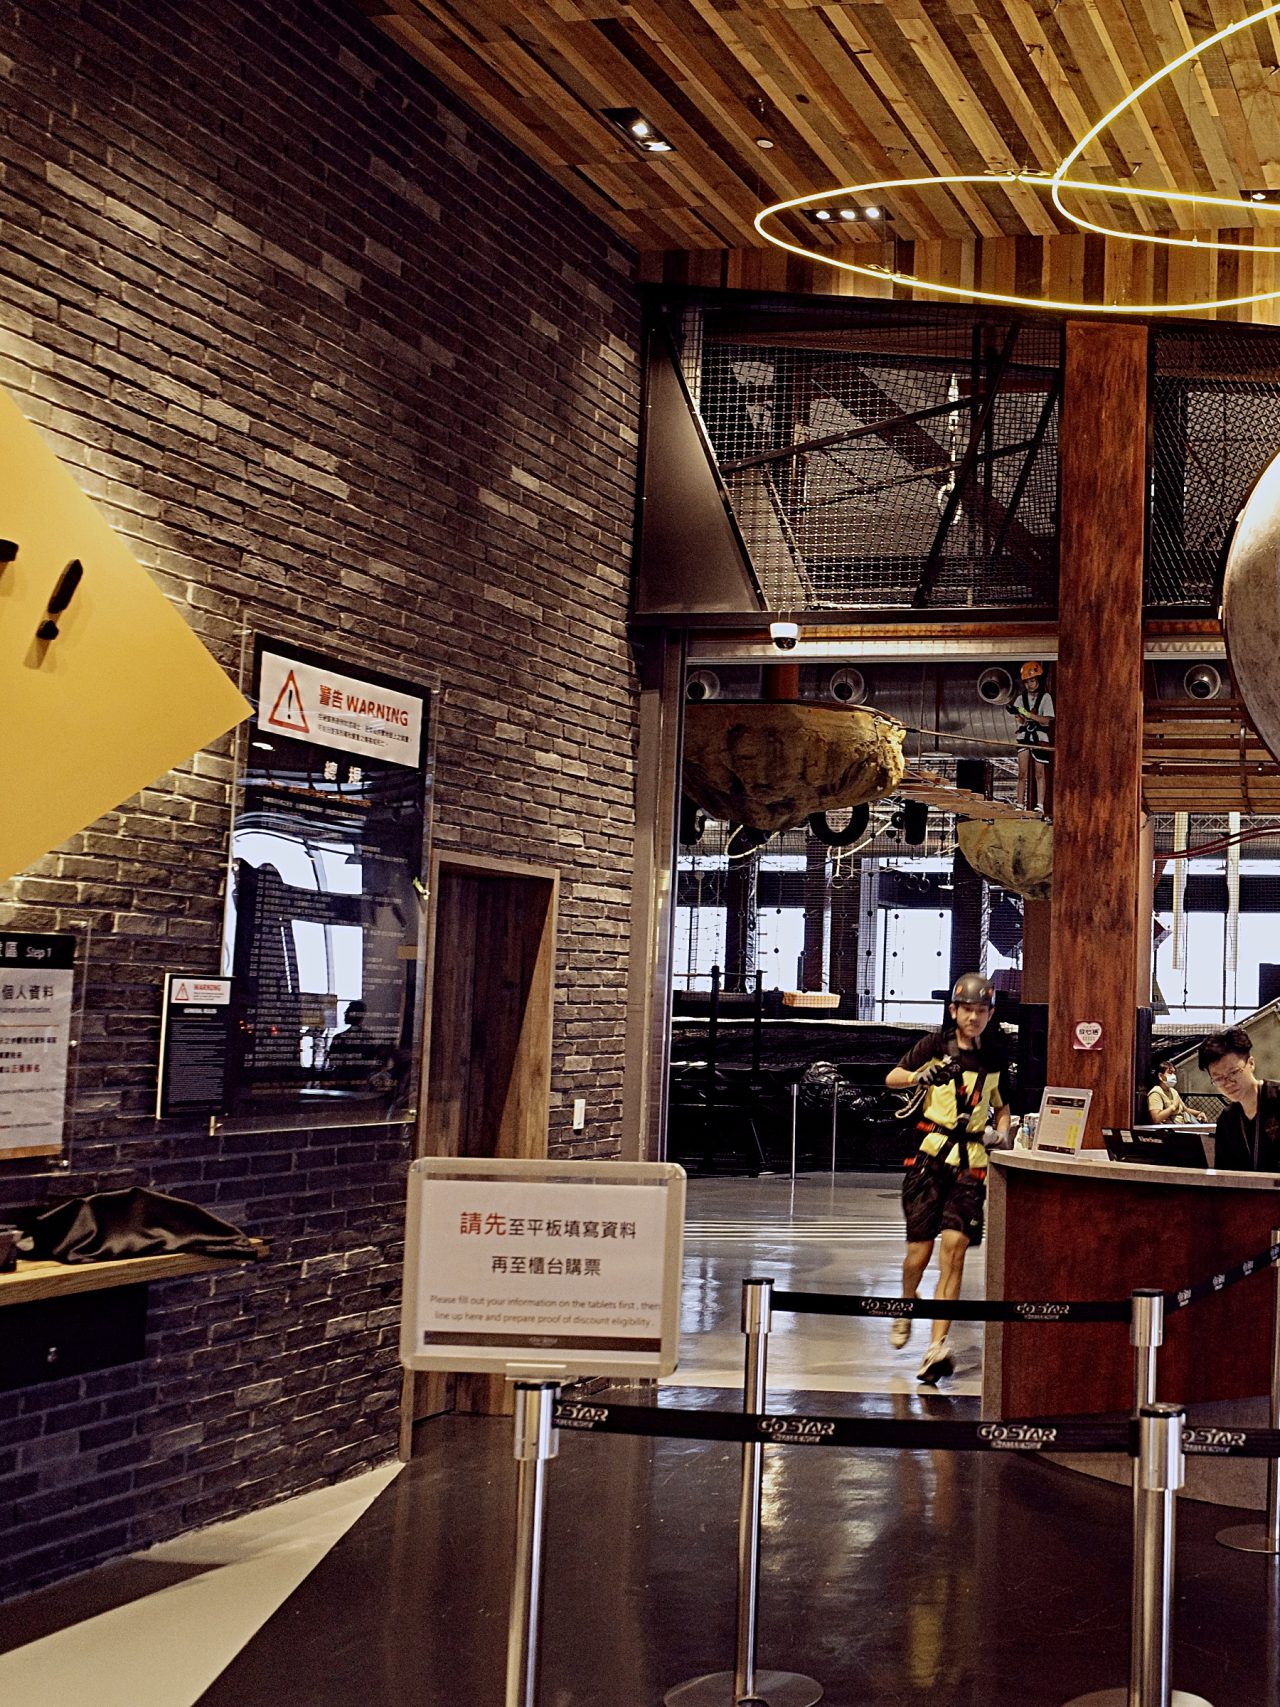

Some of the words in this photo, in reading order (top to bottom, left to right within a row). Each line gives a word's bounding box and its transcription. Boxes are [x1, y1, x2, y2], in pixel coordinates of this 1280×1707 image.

[319, 684, 343, 710] 警告
[346, 694, 408, 726] WARNING
[460, 1212, 637, 1239] 請先至平板填寫資料
[491, 1256, 602, 1277] 再至櫃台購票
[430, 1295, 457, 1304] Please
[458, 1295, 469, 1304] fill
[470, 1297, 485, 1305] out
[486, 1298, 505, 1308] your
[505, 1297, 557, 1307] information
[558, 1301, 571, 1309] on
[572, 1300, 586, 1309] the
[588, 1300, 617, 1310] tablets
[452, 1313, 463, 1322] up
[465, 1312, 483, 1321] here
[485, 1313, 502, 1322] and
[503, 1315, 537, 1325] prepare
[537, 1314, 562, 1325] proof
[563, 1315, 571, 1324] of
[573, 1315, 609, 1326] discount
